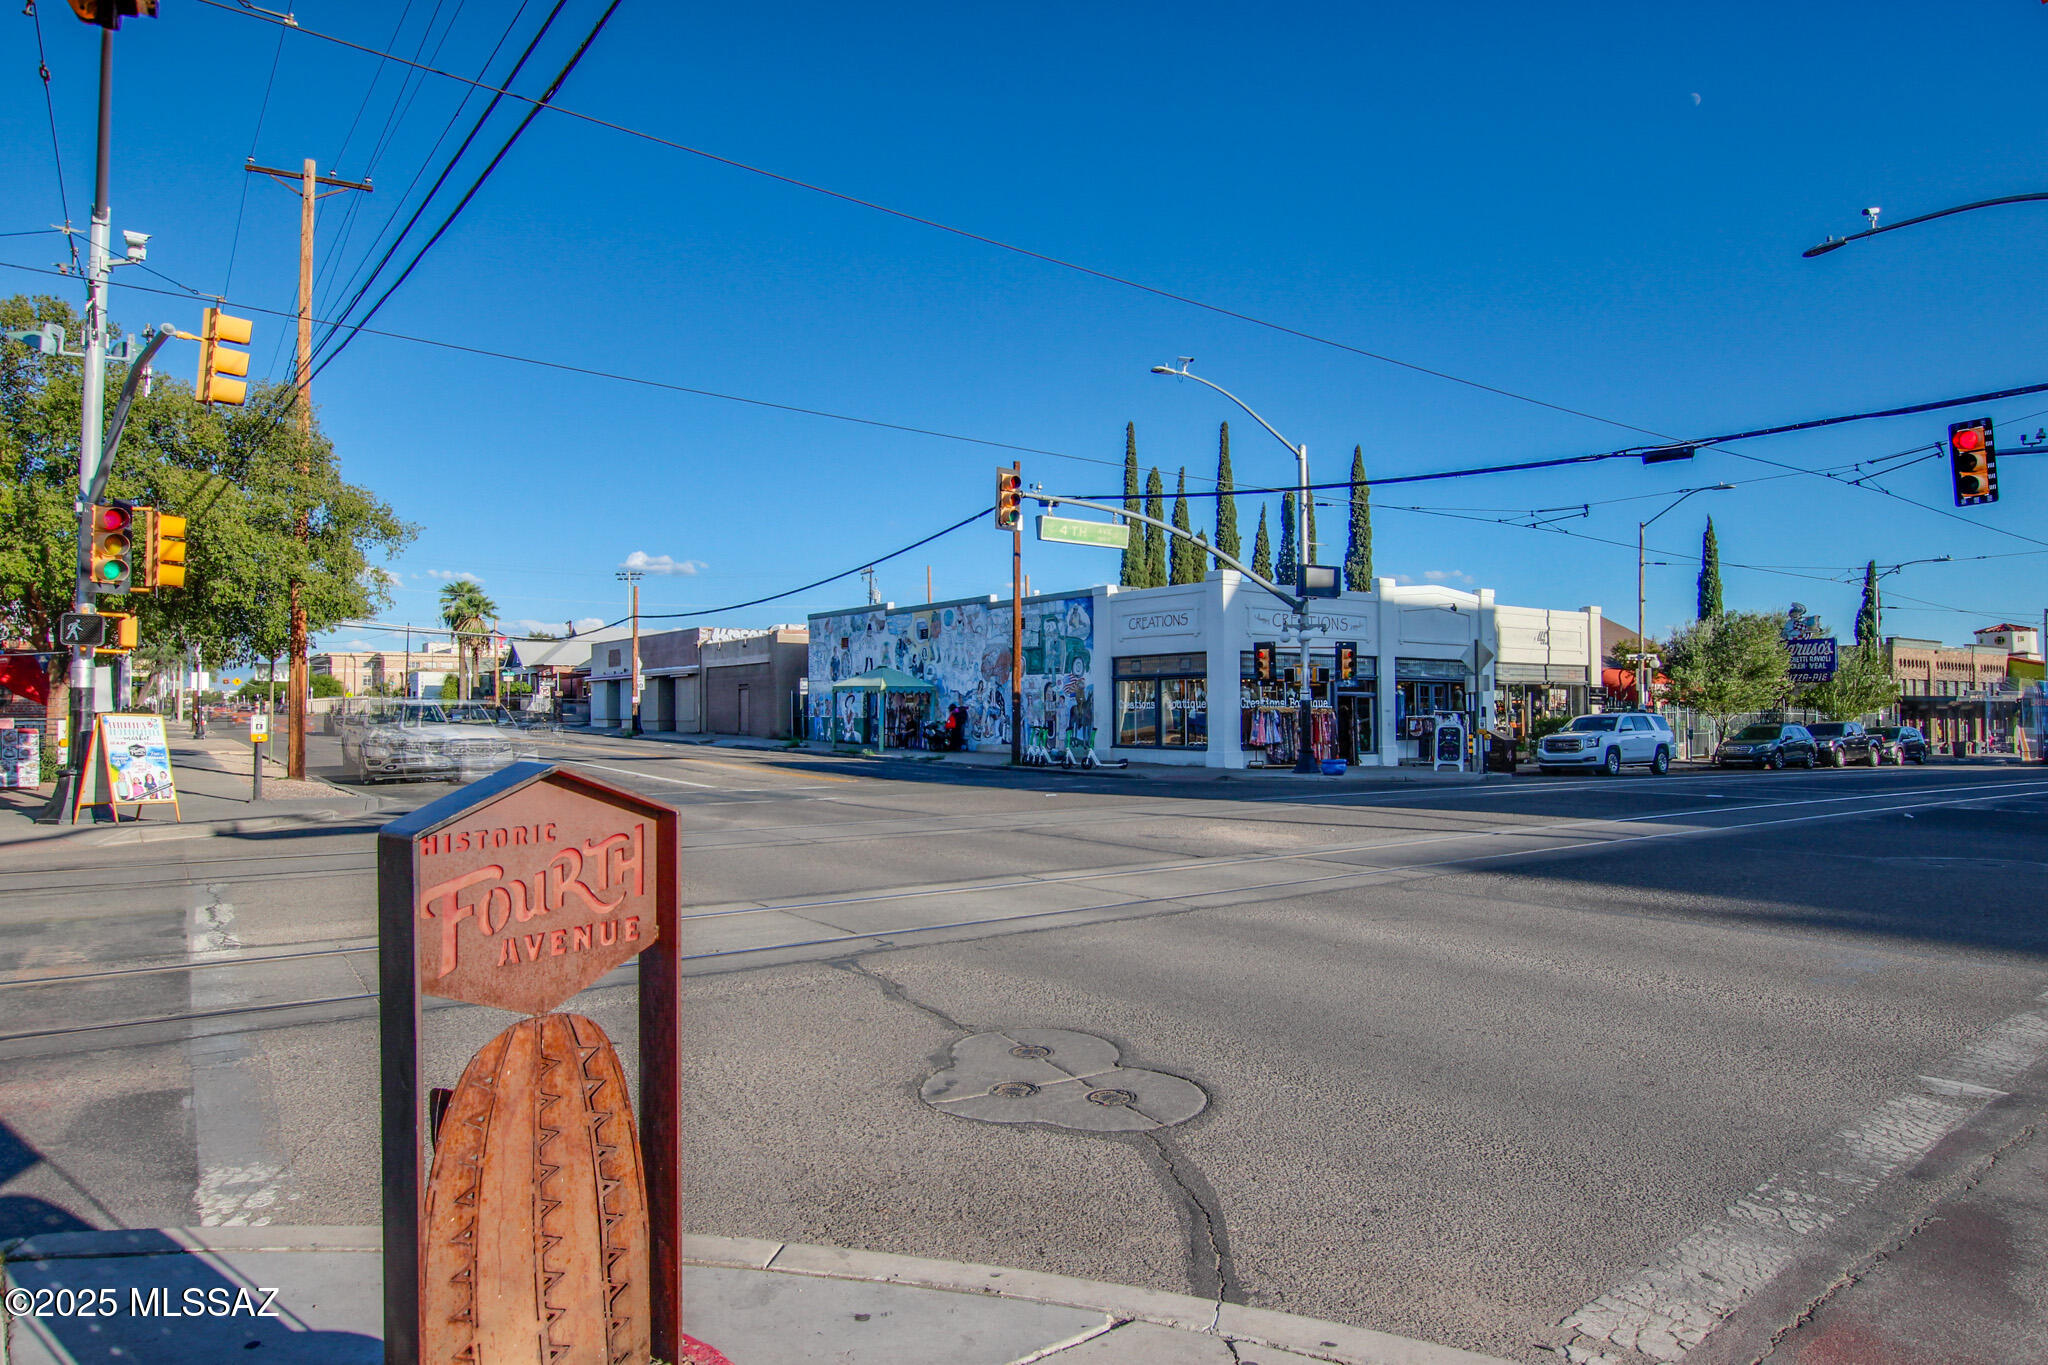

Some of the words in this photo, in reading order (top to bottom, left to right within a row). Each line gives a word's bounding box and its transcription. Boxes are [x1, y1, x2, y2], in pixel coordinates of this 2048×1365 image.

[1059, 525, 1088, 537] 4TH
[1128, 612, 1189, 631] CREATIONS
[1272, 613, 1349, 632] CRETIONS
[1785, 640, 1833, 656] aruso's
[1788, 673, 1828, 682] IZZA-PIE
[1167, 699, 1207, 711] outique
[1289, 697, 1329, 709] Boique
[420, 823, 557, 856] HISTORIC
[420, 823, 645, 979] FOURTH
[497, 915, 641, 967] AVENUE
